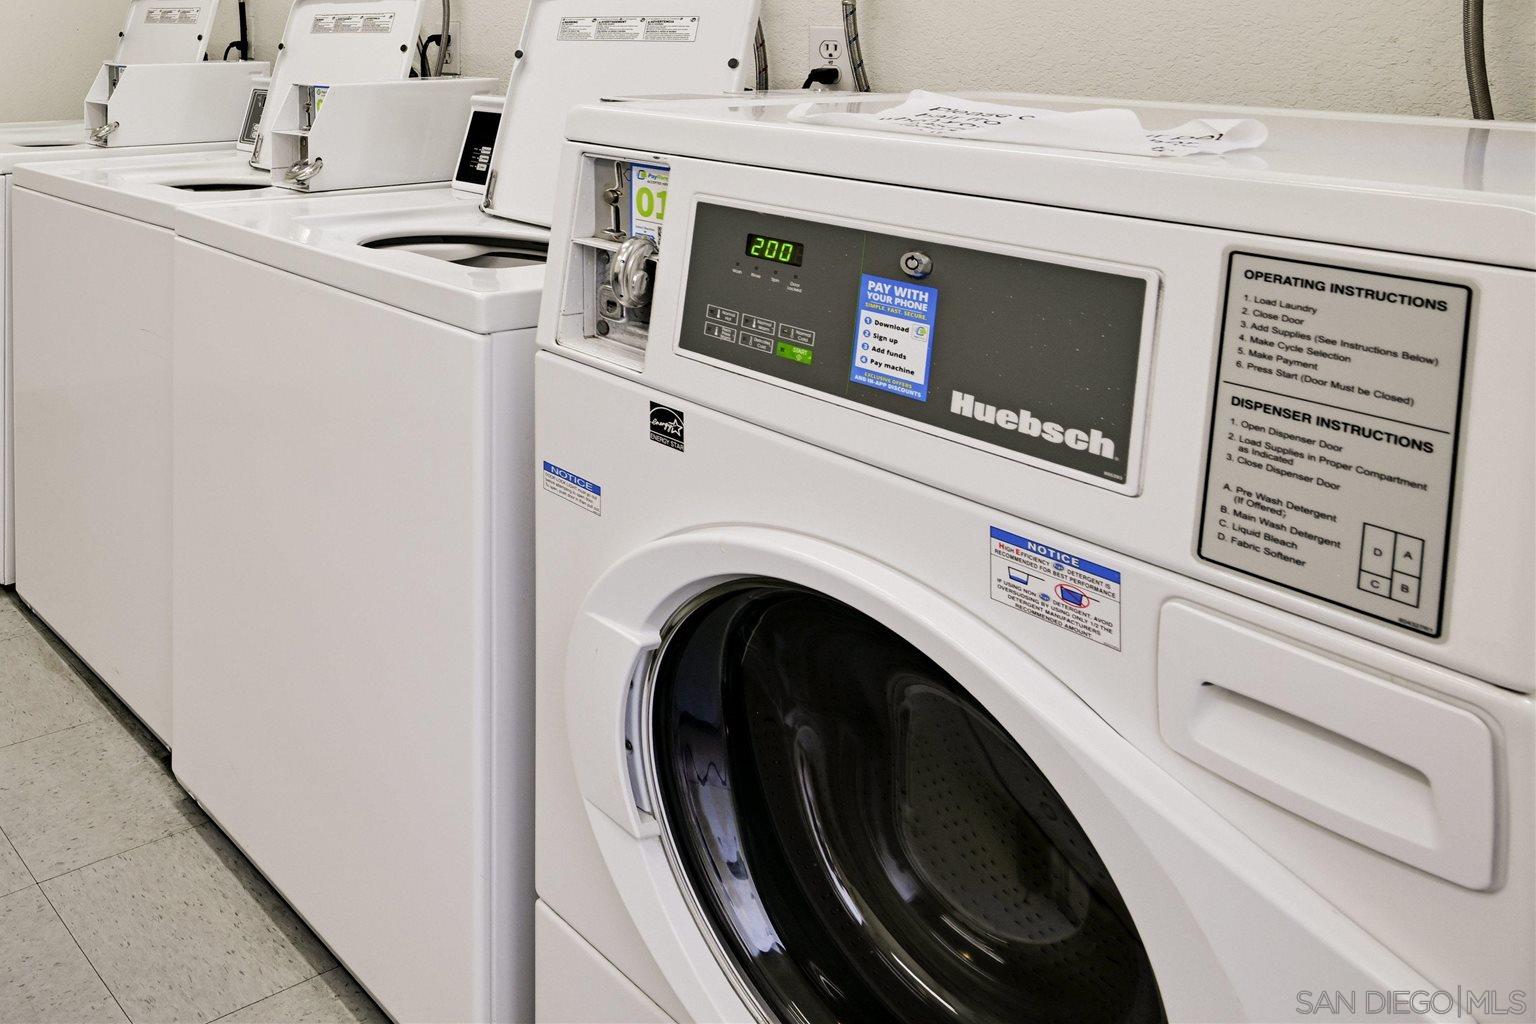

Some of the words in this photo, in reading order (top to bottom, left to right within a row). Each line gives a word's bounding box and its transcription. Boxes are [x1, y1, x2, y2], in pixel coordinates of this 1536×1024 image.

[636, 186, 667, 220] 01
[751, 237, 793, 262] 200
[867, 281, 892, 295] PAY
[894, 285, 928, 302] WITH
[867, 291, 892, 304] YOUR
[895, 297, 928, 312] PHONE
[1244, 269, 1325, 292] OPERATING
[1330, 283, 1448, 312] INSTRUCTIONS
[1254, 296, 1277, 307] Load
[1279, 300, 1317, 315] Laundry
[874, 319, 910, 333] Download
[1252, 309, 1279, 321] Close
[1281, 315, 1305, 325] Door
[873, 333, 887, 342] Sign
[1240, 320, 1248, 329] 3.
[1250, 322, 1269, 332] Add
[1271, 326, 1312, 341] Supplies
[1314, 335, 1337, 346] (See
[1340, 339, 1399, 358] Instructions
[1401, 351, 1439, 367] Below)
[1249, 336, 1275, 347] Make
[1277, 341, 1304, 353] Cycle
[1306, 347, 1351, 363] Selection
[870, 358, 882, 368] Pay
[884, 363, 915, 376] machine
[871, 346, 885, 354] Add
[886, 349, 907, 360] funds
[1237, 347, 1245, 355] 5.
[1248, 349, 1273, 361] Make
[1276, 354, 1318, 371] Payment
[1235, 360, 1244, 369] 6.
[1247, 362, 1273, 375] Press
[1275, 368, 1298, 380] Start
[1300, 374, 1328, 387] (Door
[1330, 380, 1355, 393] Must
[1357, 386, 1370, 397] be
[1373, 390, 1415, 406] Closed)
[650, 432, 670, 446] ENERGY
[950, 390, 1115, 460] Huebsch
[1231, 396, 1312, 424] DISPENSER
[1316, 416, 1434, 454] INSTRUCTIONS
[1241, 420, 1265, 432] Open
[1268, 427, 1316, 445] Dispenser
[1319, 439, 1343, 452] Door
[1228, 432, 1236, 441] 2.
[1239, 436, 1262, 447] Load
[1264, 441, 1305, 459] Supplies
[1307, 452, 1316, 462] in
[1319, 456, 1353, 471] Proper
[1355, 465, 1428, 491] Compartment
[1238, 446, 1249, 454] as
[1252, 448, 1294, 466] Indicated
[551, 465, 593, 491] NOTICE
[1226, 453, 1234, 462] 3.
[1237, 456, 1263, 470] Close
[1266, 463, 1314, 483] Dispenser
[1316, 477, 1341, 490] Door
[1223, 483, 1232, 492] A.
[1236, 486, 1253, 497] Pre
[1255, 492, 1283, 506] Wash
[1286, 500, 1337, 523] Detergent
[1218, 519, 1229, 528] C.
[1232, 523, 1261, 538] Liquid
[1263, 532, 1298, 550] Bleach
[1220, 505, 1230, 514] B.
[1233, 509, 1256, 522] Main
[1259, 517, 1287, 532] Wash
[1290, 526, 1341, 549] Detergent
[998, 542, 1015, 554] HIGH
[1015, 549, 1050, 566] EFFICIENCY
[1066, 569, 1104, 587] DETERGENT
[1027, 541, 1080, 567] NOTICE
[1217, 532, 1227, 542] D.
[1230, 536, 1261, 553] Fabric
[1263, 547, 1306, 567] Softener
[1373, 547, 1383, 557] D
[1403, 551, 1413, 560] A
[994, 549, 1038, 571] RECOMMENDED
[1039, 565, 1052, 574] FOR
[1052, 570, 1069, 582] BEST
[1069, 576, 1116, 599] PERFORMANCE
[1370, 580, 1380, 589] C
[1400, 583, 1410, 593] B
[1003, 581, 1022, 592] USING
[1023, 587, 1036, 597] NON
[1093, 617, 1113, 628] AVOID
[1007, 594, 1043, 612] DETERGENT
[1045, 609, 1101, 636] MANUFACTURERS
[1050, 604, 1070, 617] USING
[1072, 613, 1089, 624] ONLY
[1100, 625, 1112, 634] THE
[1015, 603, 1063, 626] RECOMMENDED
[1064, 622, 1092, 638] AMOUNT
